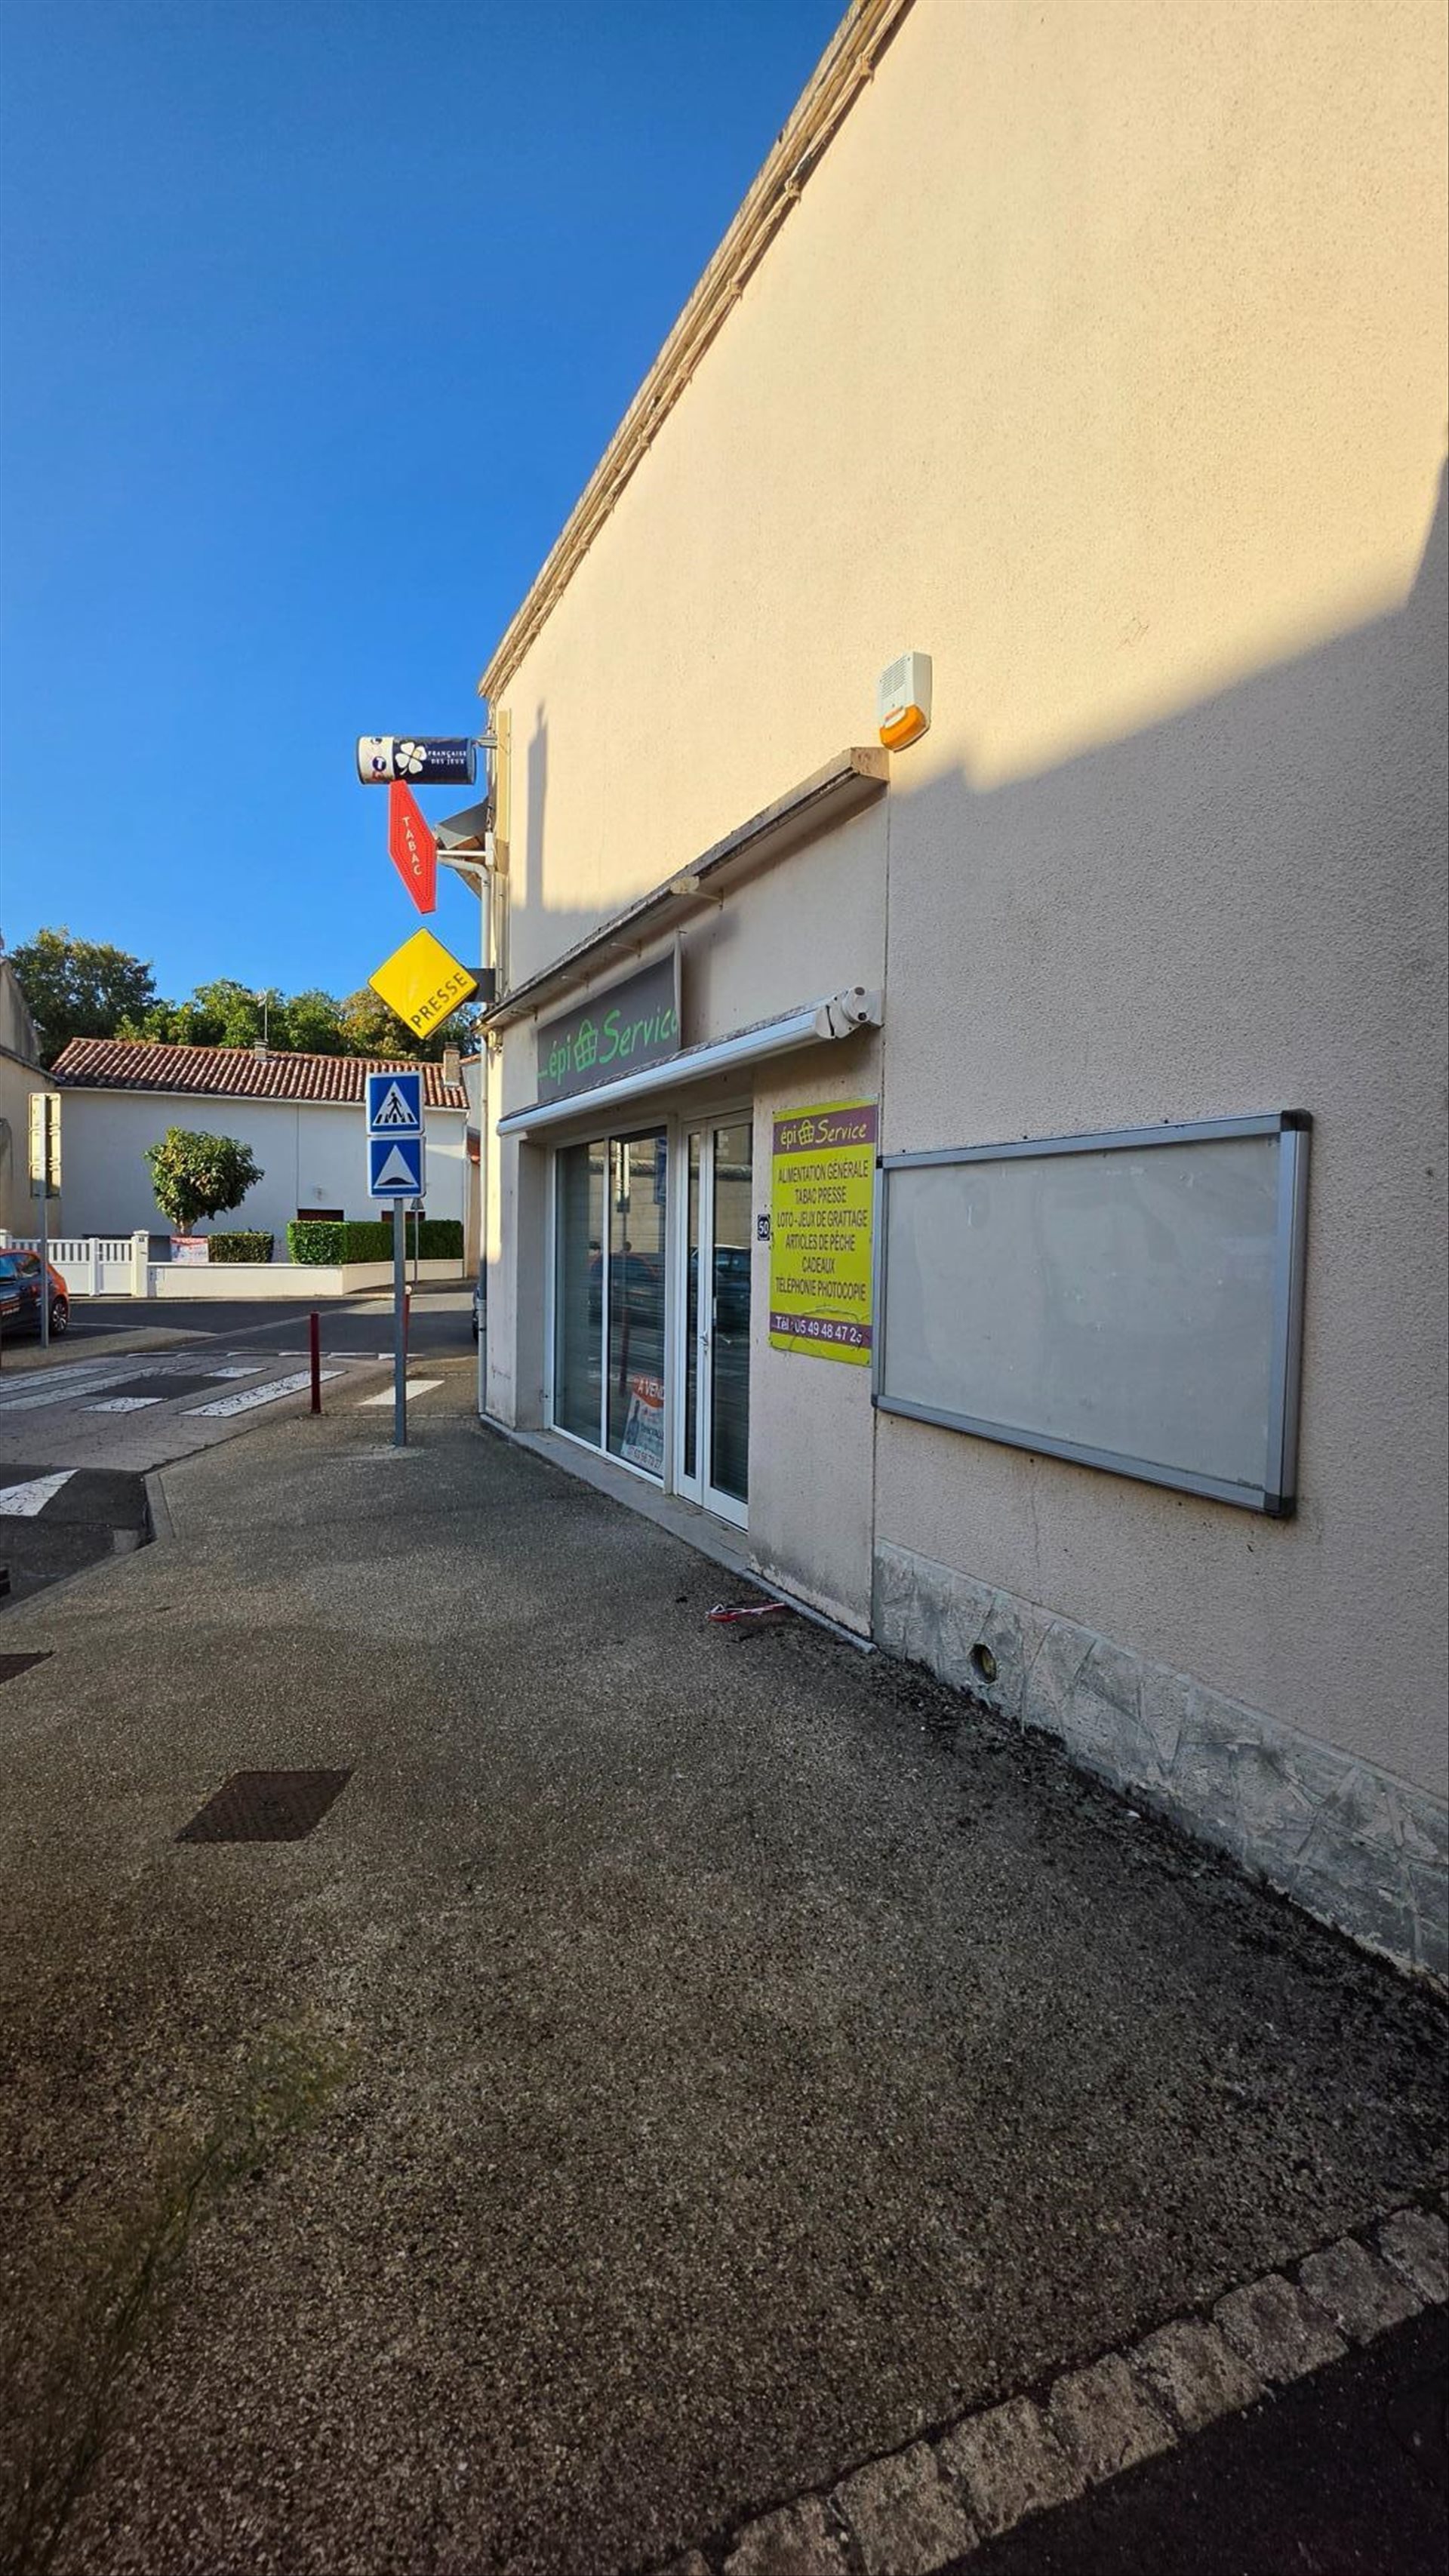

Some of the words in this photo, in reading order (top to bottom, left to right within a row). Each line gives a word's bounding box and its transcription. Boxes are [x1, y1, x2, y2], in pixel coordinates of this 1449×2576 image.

[401, 816, 423, 876] TABAC
[410, 972, 468, 1029] PRESSE
[780, 1125, 797, 1150] épi
[816, 1119, 866, 1143] Service
[777, 1165, 826, 1183] ALIMENTATION
[827, 1159, 868, 1180] GÉNÉRALE
[795, 1187, 816, 1205] TABAC
[817, 1186, 847, 1204] PRESSE
[757, 1220, 769, 1235] 50
[777, 1211, 793, 1228] LOTO
[798, 1211, 815, 1227] JEUX
[817, 1211, 826, 1227] DE
[827, 1209, 868, 1227] GRATTAGE
[786, 1233, 817, 1251] ARTICLES
[819, 1234, 829, 1251] DE
[830, 1230, 855, 1251] PÊCHE
[801, 1257, 835, 1274] CADEAUX
[817, 1279, 866, 1301] PHOTOCOPIE
[808, 1322, 820, 1336] 49
[821, 1323, 833, 1338] 48
[835, 1325, 848, 1340] 47
